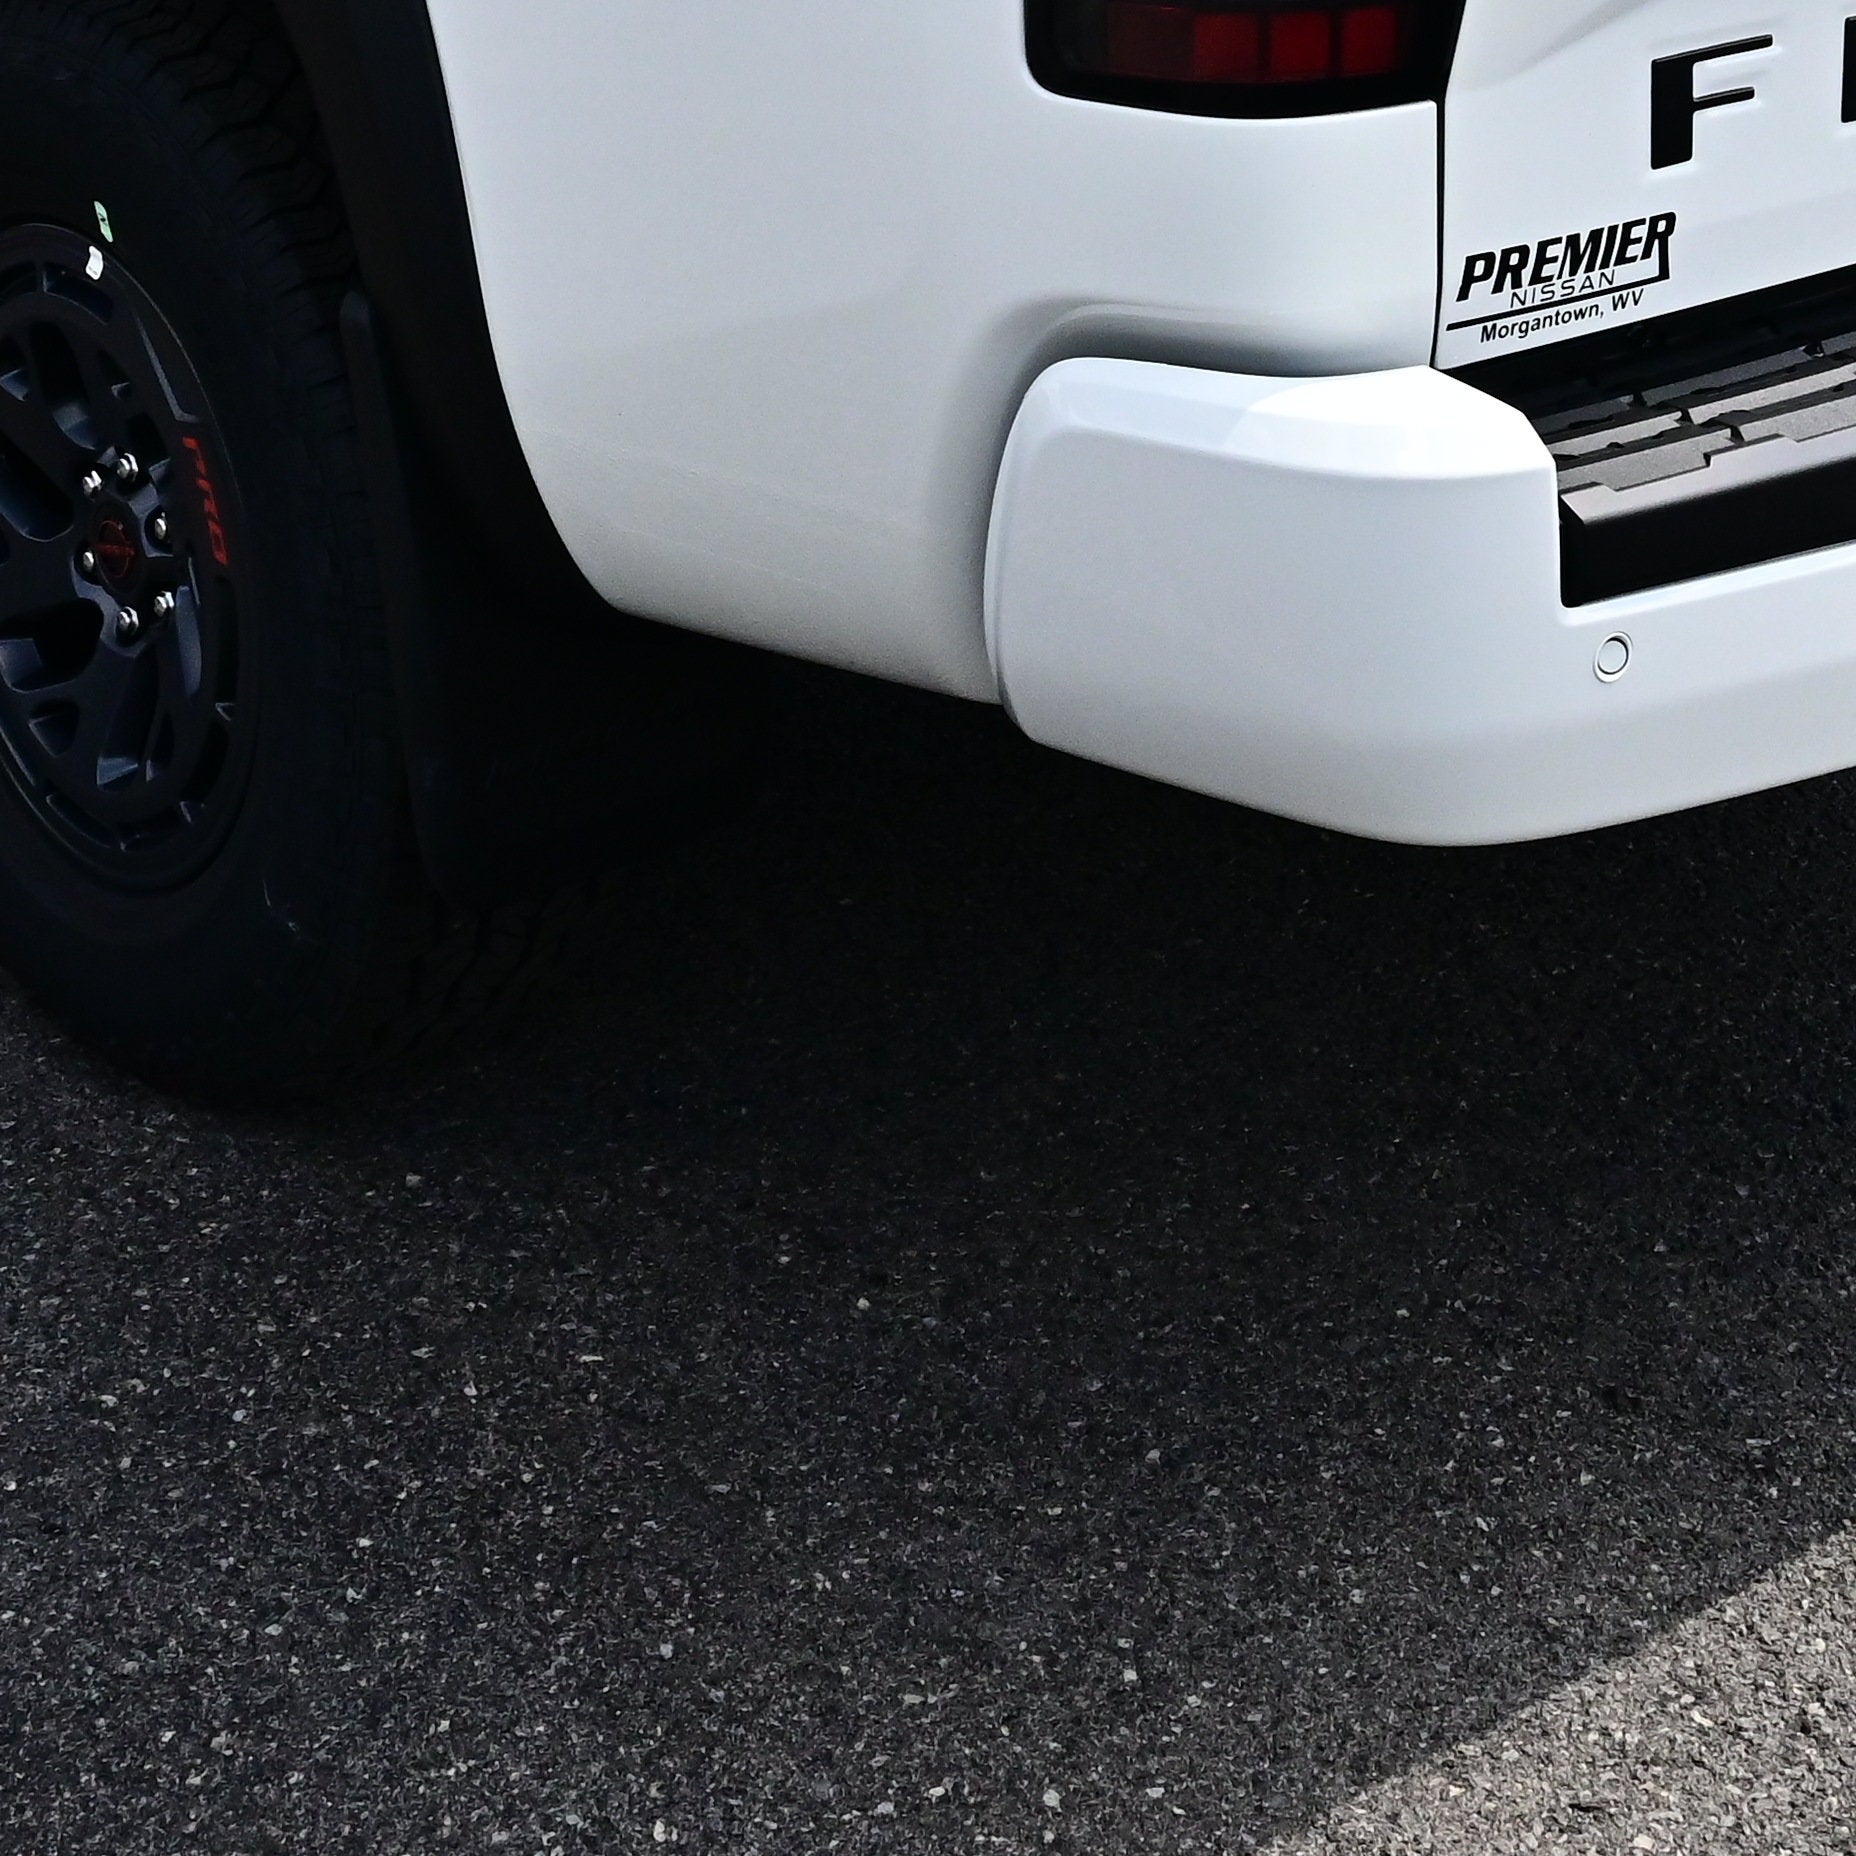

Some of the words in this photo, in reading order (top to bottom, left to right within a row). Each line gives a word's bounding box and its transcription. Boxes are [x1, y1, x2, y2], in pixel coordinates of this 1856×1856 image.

[1455, 211, 1677, 303] PREMIER
[1480, 302, 1604, 343] Morgantown,
[1611, 288, 1644, 312] WV
[1510, 269, 1616, 308] NISSAN
